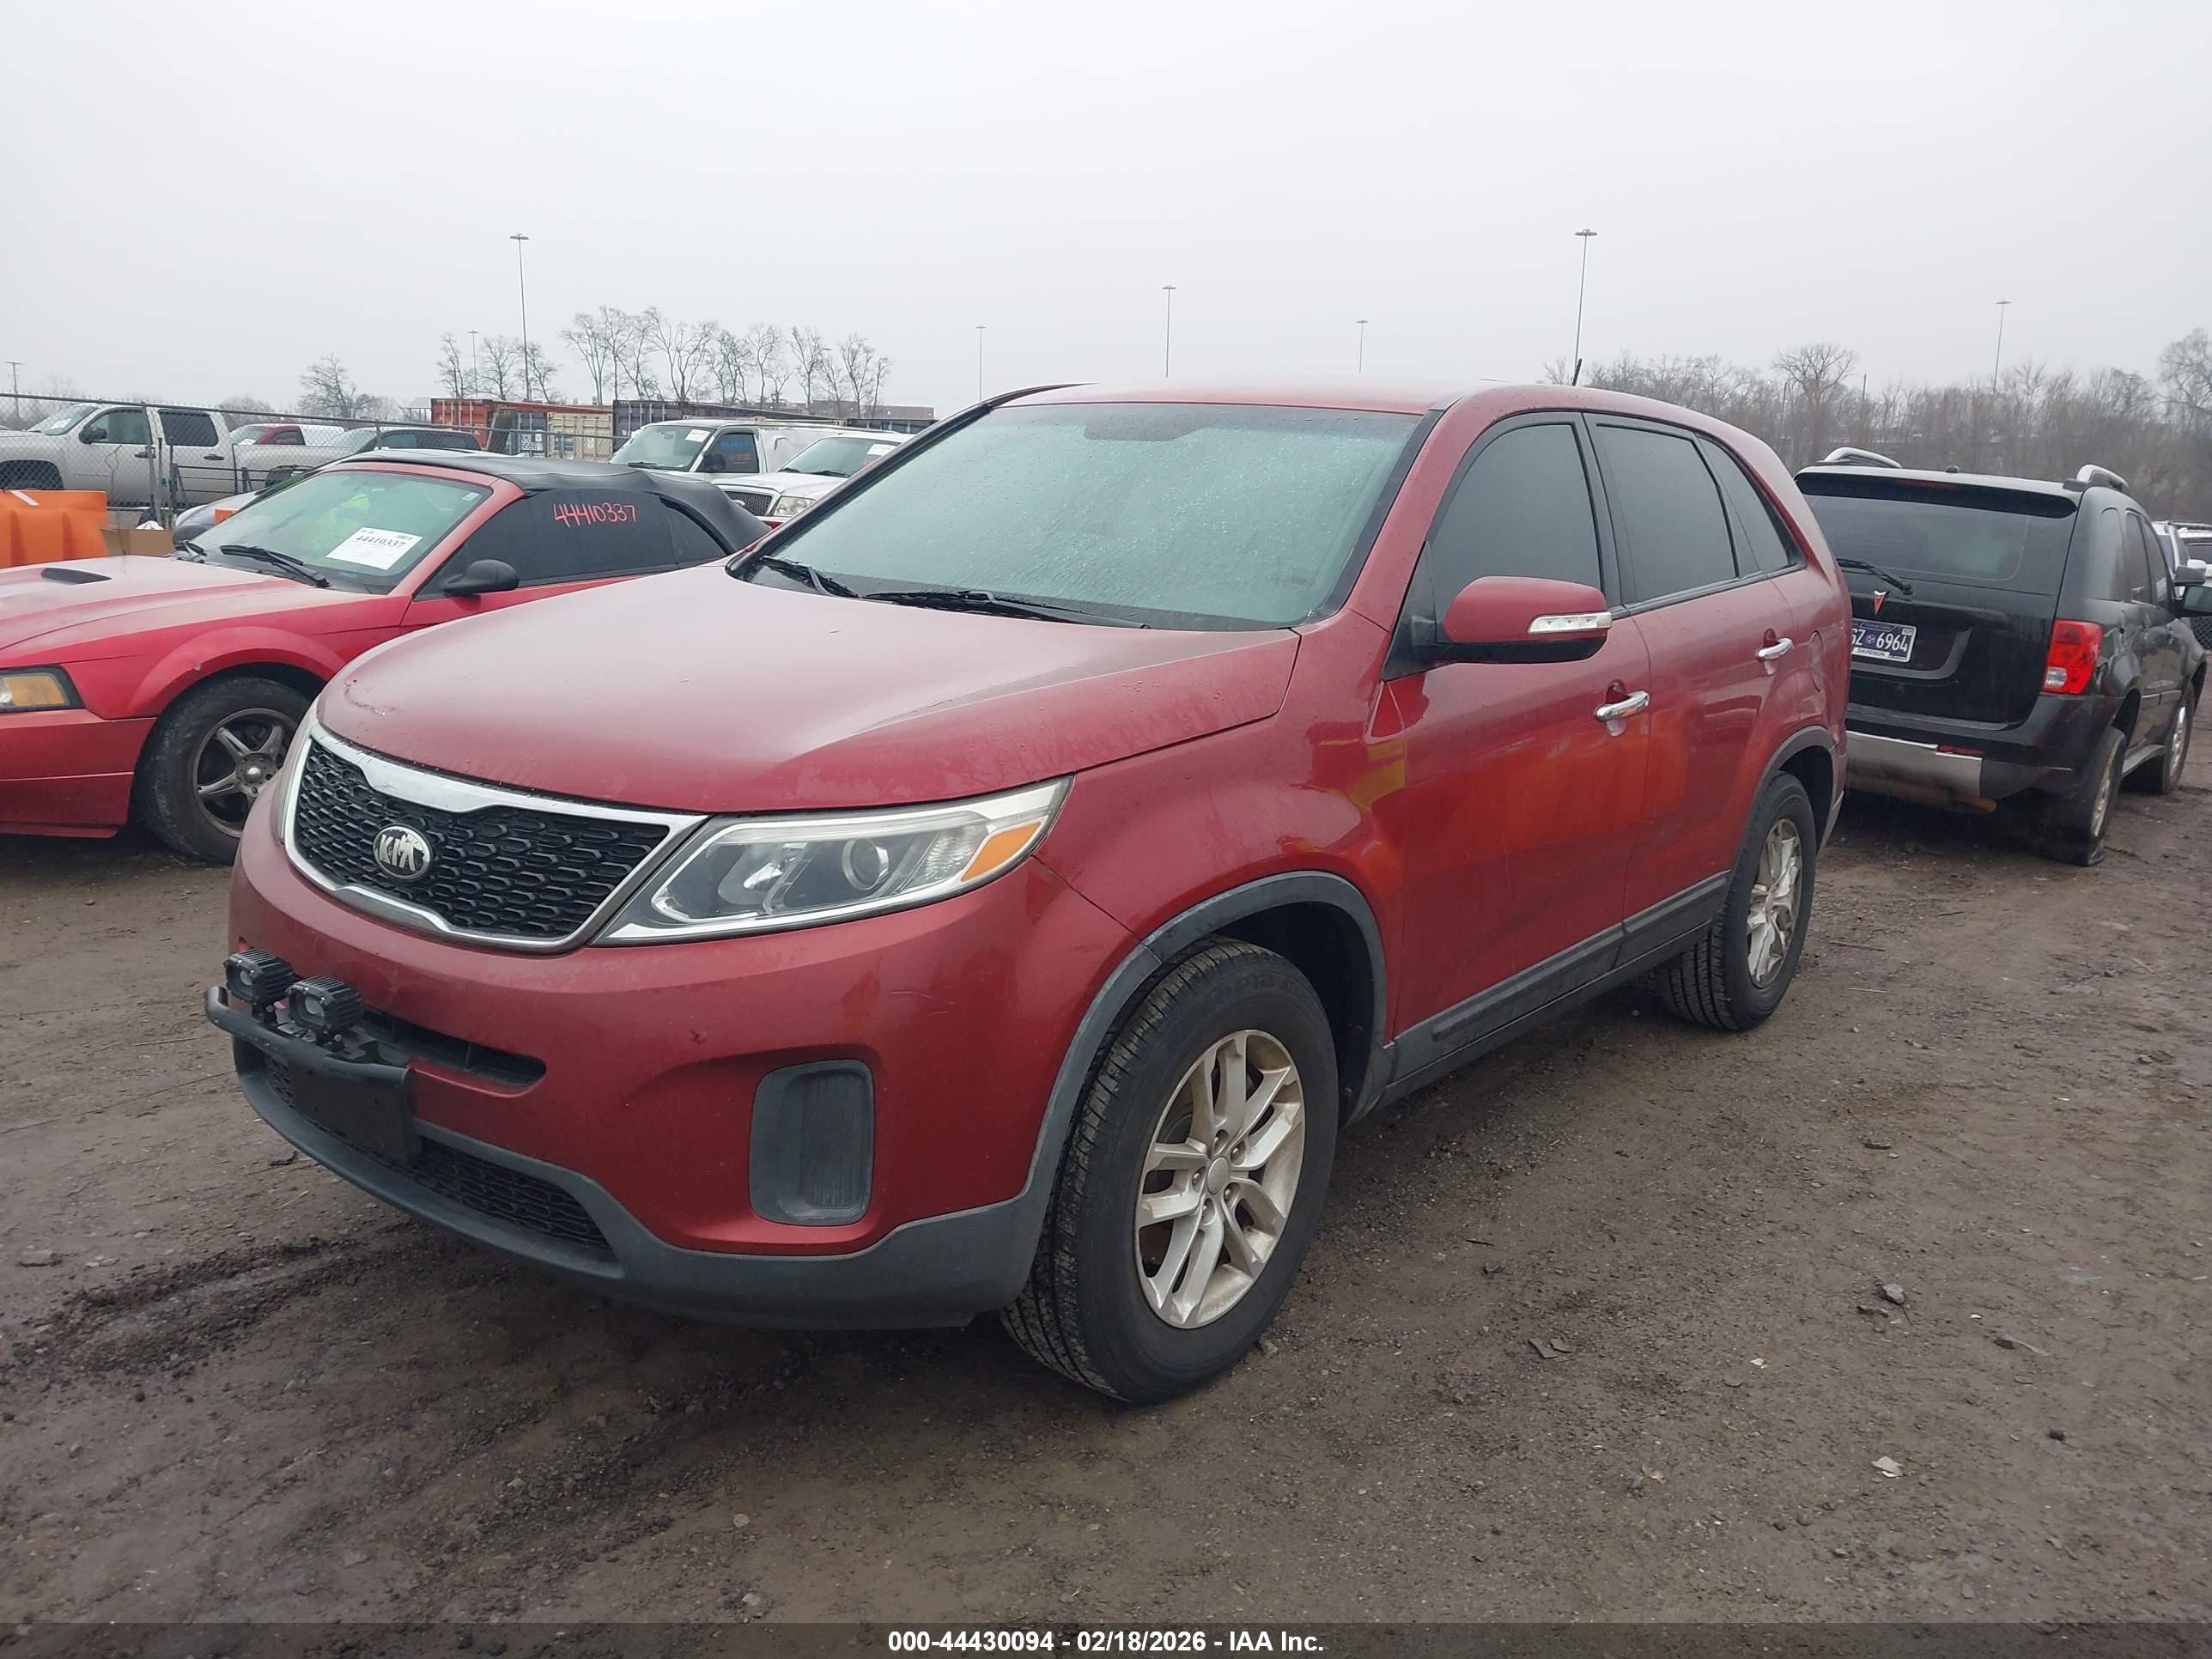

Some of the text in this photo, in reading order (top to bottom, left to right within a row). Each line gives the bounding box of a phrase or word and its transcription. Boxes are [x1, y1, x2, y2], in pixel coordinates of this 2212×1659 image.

[553, 502, 636, 527] 44410337
[356, 535, 406, 548] 44410337
[1876, 632, 1908, 653] 6964
